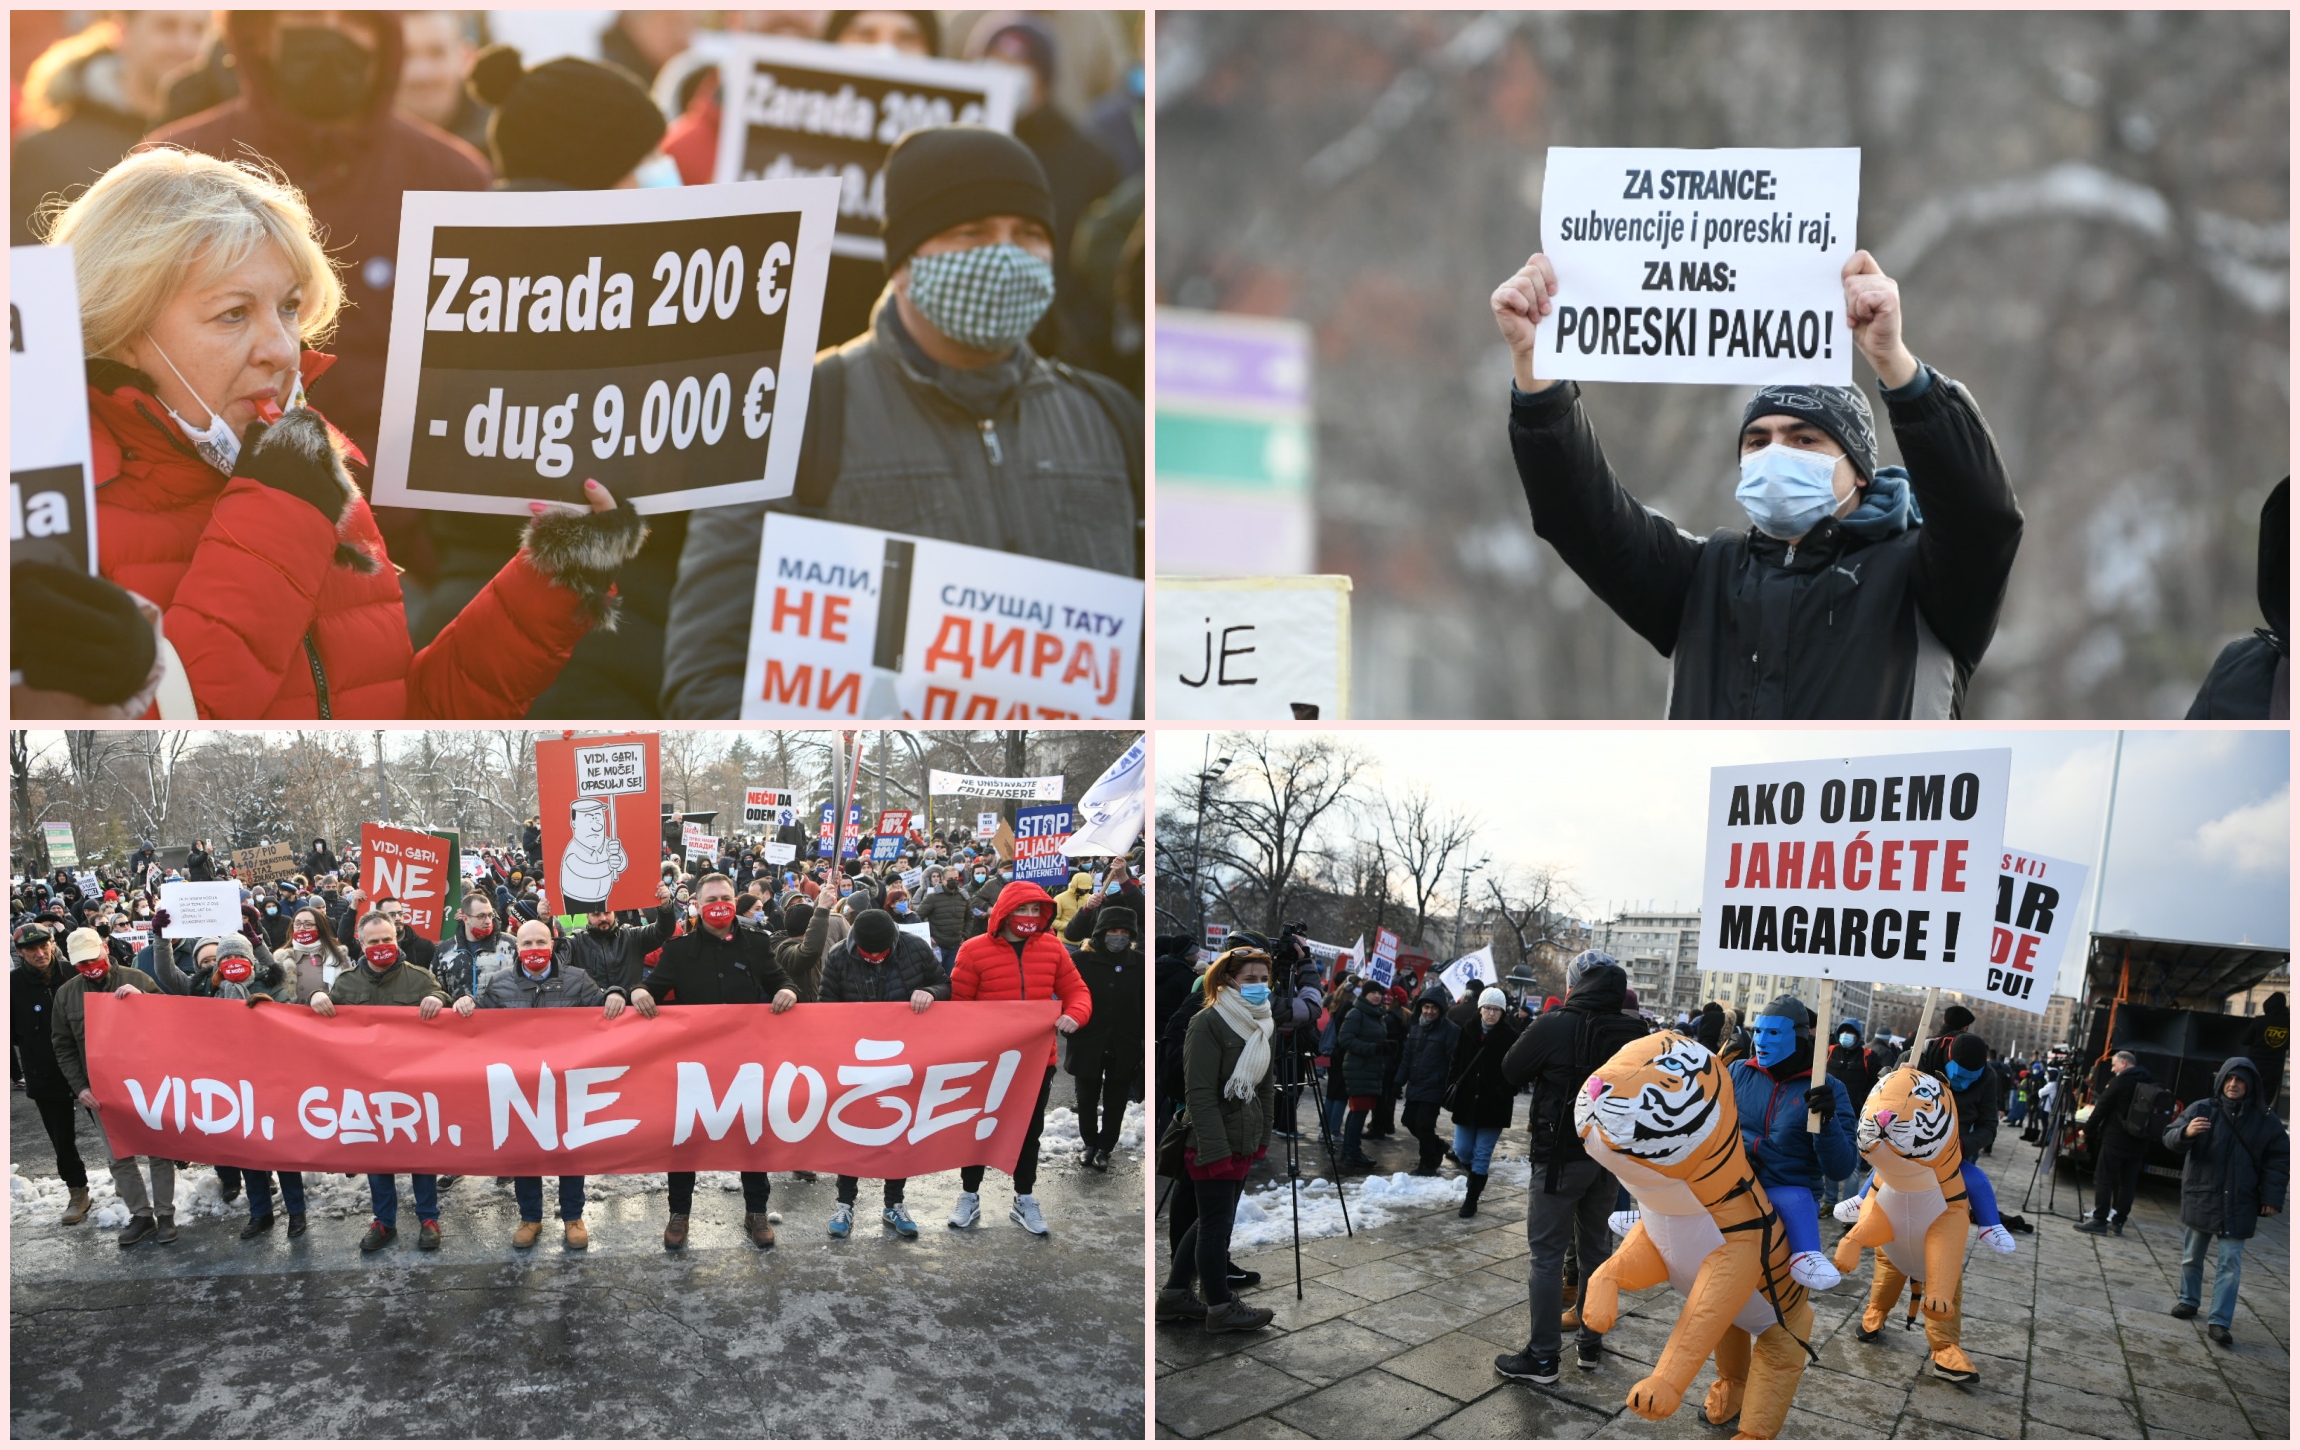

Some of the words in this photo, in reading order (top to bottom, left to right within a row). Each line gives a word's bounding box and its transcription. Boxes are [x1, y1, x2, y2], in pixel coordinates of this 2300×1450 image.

[1623, 169, 1653, 199] ZA
[1659, 169, 1777, 200] STRANCE:
[1560, 209, 1684, 249] subvencije
[1691, 211, 1698, 240] i
[1703, 211, 1792, 249] poreski
[1798, 212, 1837, 252] raj.
[426, 256, 634, 333] Zarada
[648, 245, 744, 327] 200
[756, 241, 791, 315] €
[1642, 261, 1673, 290] ZA
[1679, 262, 1737, 292] NAS:
[1555, 305, 1697, 357] PORESKI
[1708, 308, 1834, 359] PAKAO!
[464, 387, 579, 478] dug
[591, 372, 731, 459] 9.000
[742, 367, 775, 439] €
[778, 557, 877, 597] МАЛИ,
[770, 586, 851, 643] НЕ
[940, 584, 1054, 630] СЛУШАЈ
[1062, 606, 1124, 638] ТАТУ
[925, 614, 1121, 706] ДИРАЈ
[762, 659, 862, 716] МИ
[588, 768, 601, 777] NE
[612, 751, 637, 762] GARI,
[627, 776, 642, 788] SE!
[748, 790, 776, 806] NEĆU
[778, 794, 792, 807] DA
[1727, 781, 1805, 826] AKO
[1819, 772, 1980, 824] ODEMO
[746, 808, 776, 822] ODEM
[824, 809, 858, 824] SP
[880, 818, 904, 834] 10%
[1018, 812, 1070, 838] STOP
[371, 840, 402, 856] VIDI,
[405, 847, 440, 864] GARI,
[1016, 854, 1067, 872] RADNIKA
[1724, 830, 1969, 893] JAHAĆETE
[372, 856, 436, 900] NE
[1016, 870, 1024, 880] NA
[1026, 866, 1067, 879] INTERNETU!
[1719, 904, 1930, 961] MAGARCE
[1943, 911, 1961, 963] !
[1986, 968, 2034, 1000] CU!
[124, 1076, 275, 1141] VIDI,
[297, 1086, 462, 1147] GARI,
[485, 1059, 641, 1151] NE
[673, 1038, 1022, 1146] MOŽE!
